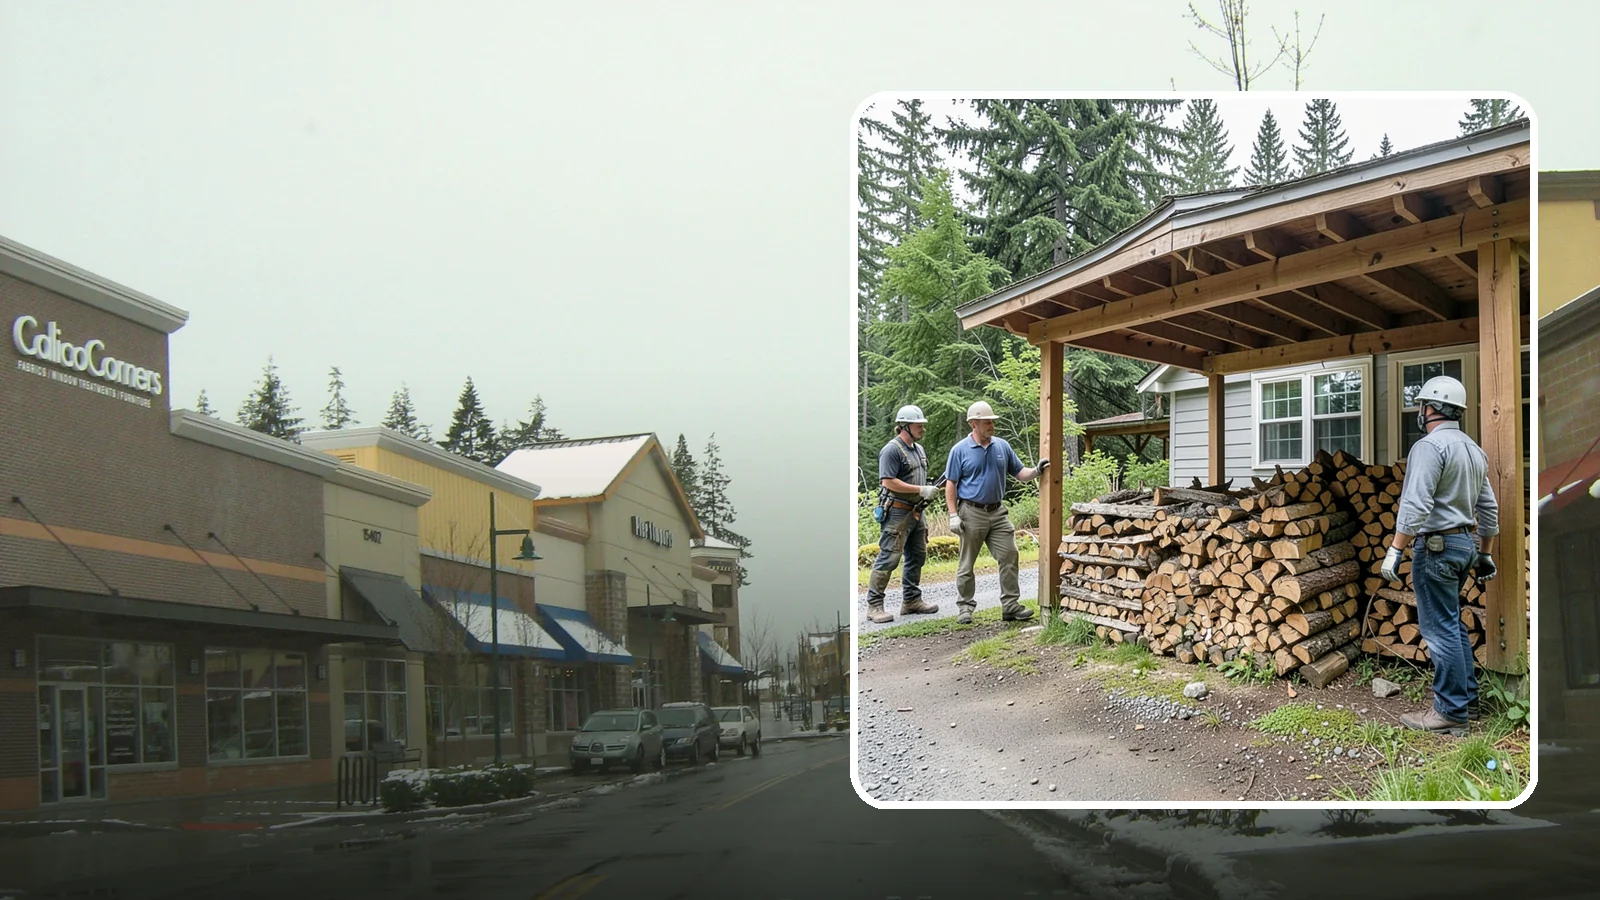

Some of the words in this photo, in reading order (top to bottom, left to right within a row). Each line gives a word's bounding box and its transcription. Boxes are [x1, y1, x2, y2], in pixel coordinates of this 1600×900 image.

[17, 360, 47, 378] FABRICS
[51, 371, 78, 386] WINDOW
[78, 378, 116, 398] TREATMENTS
